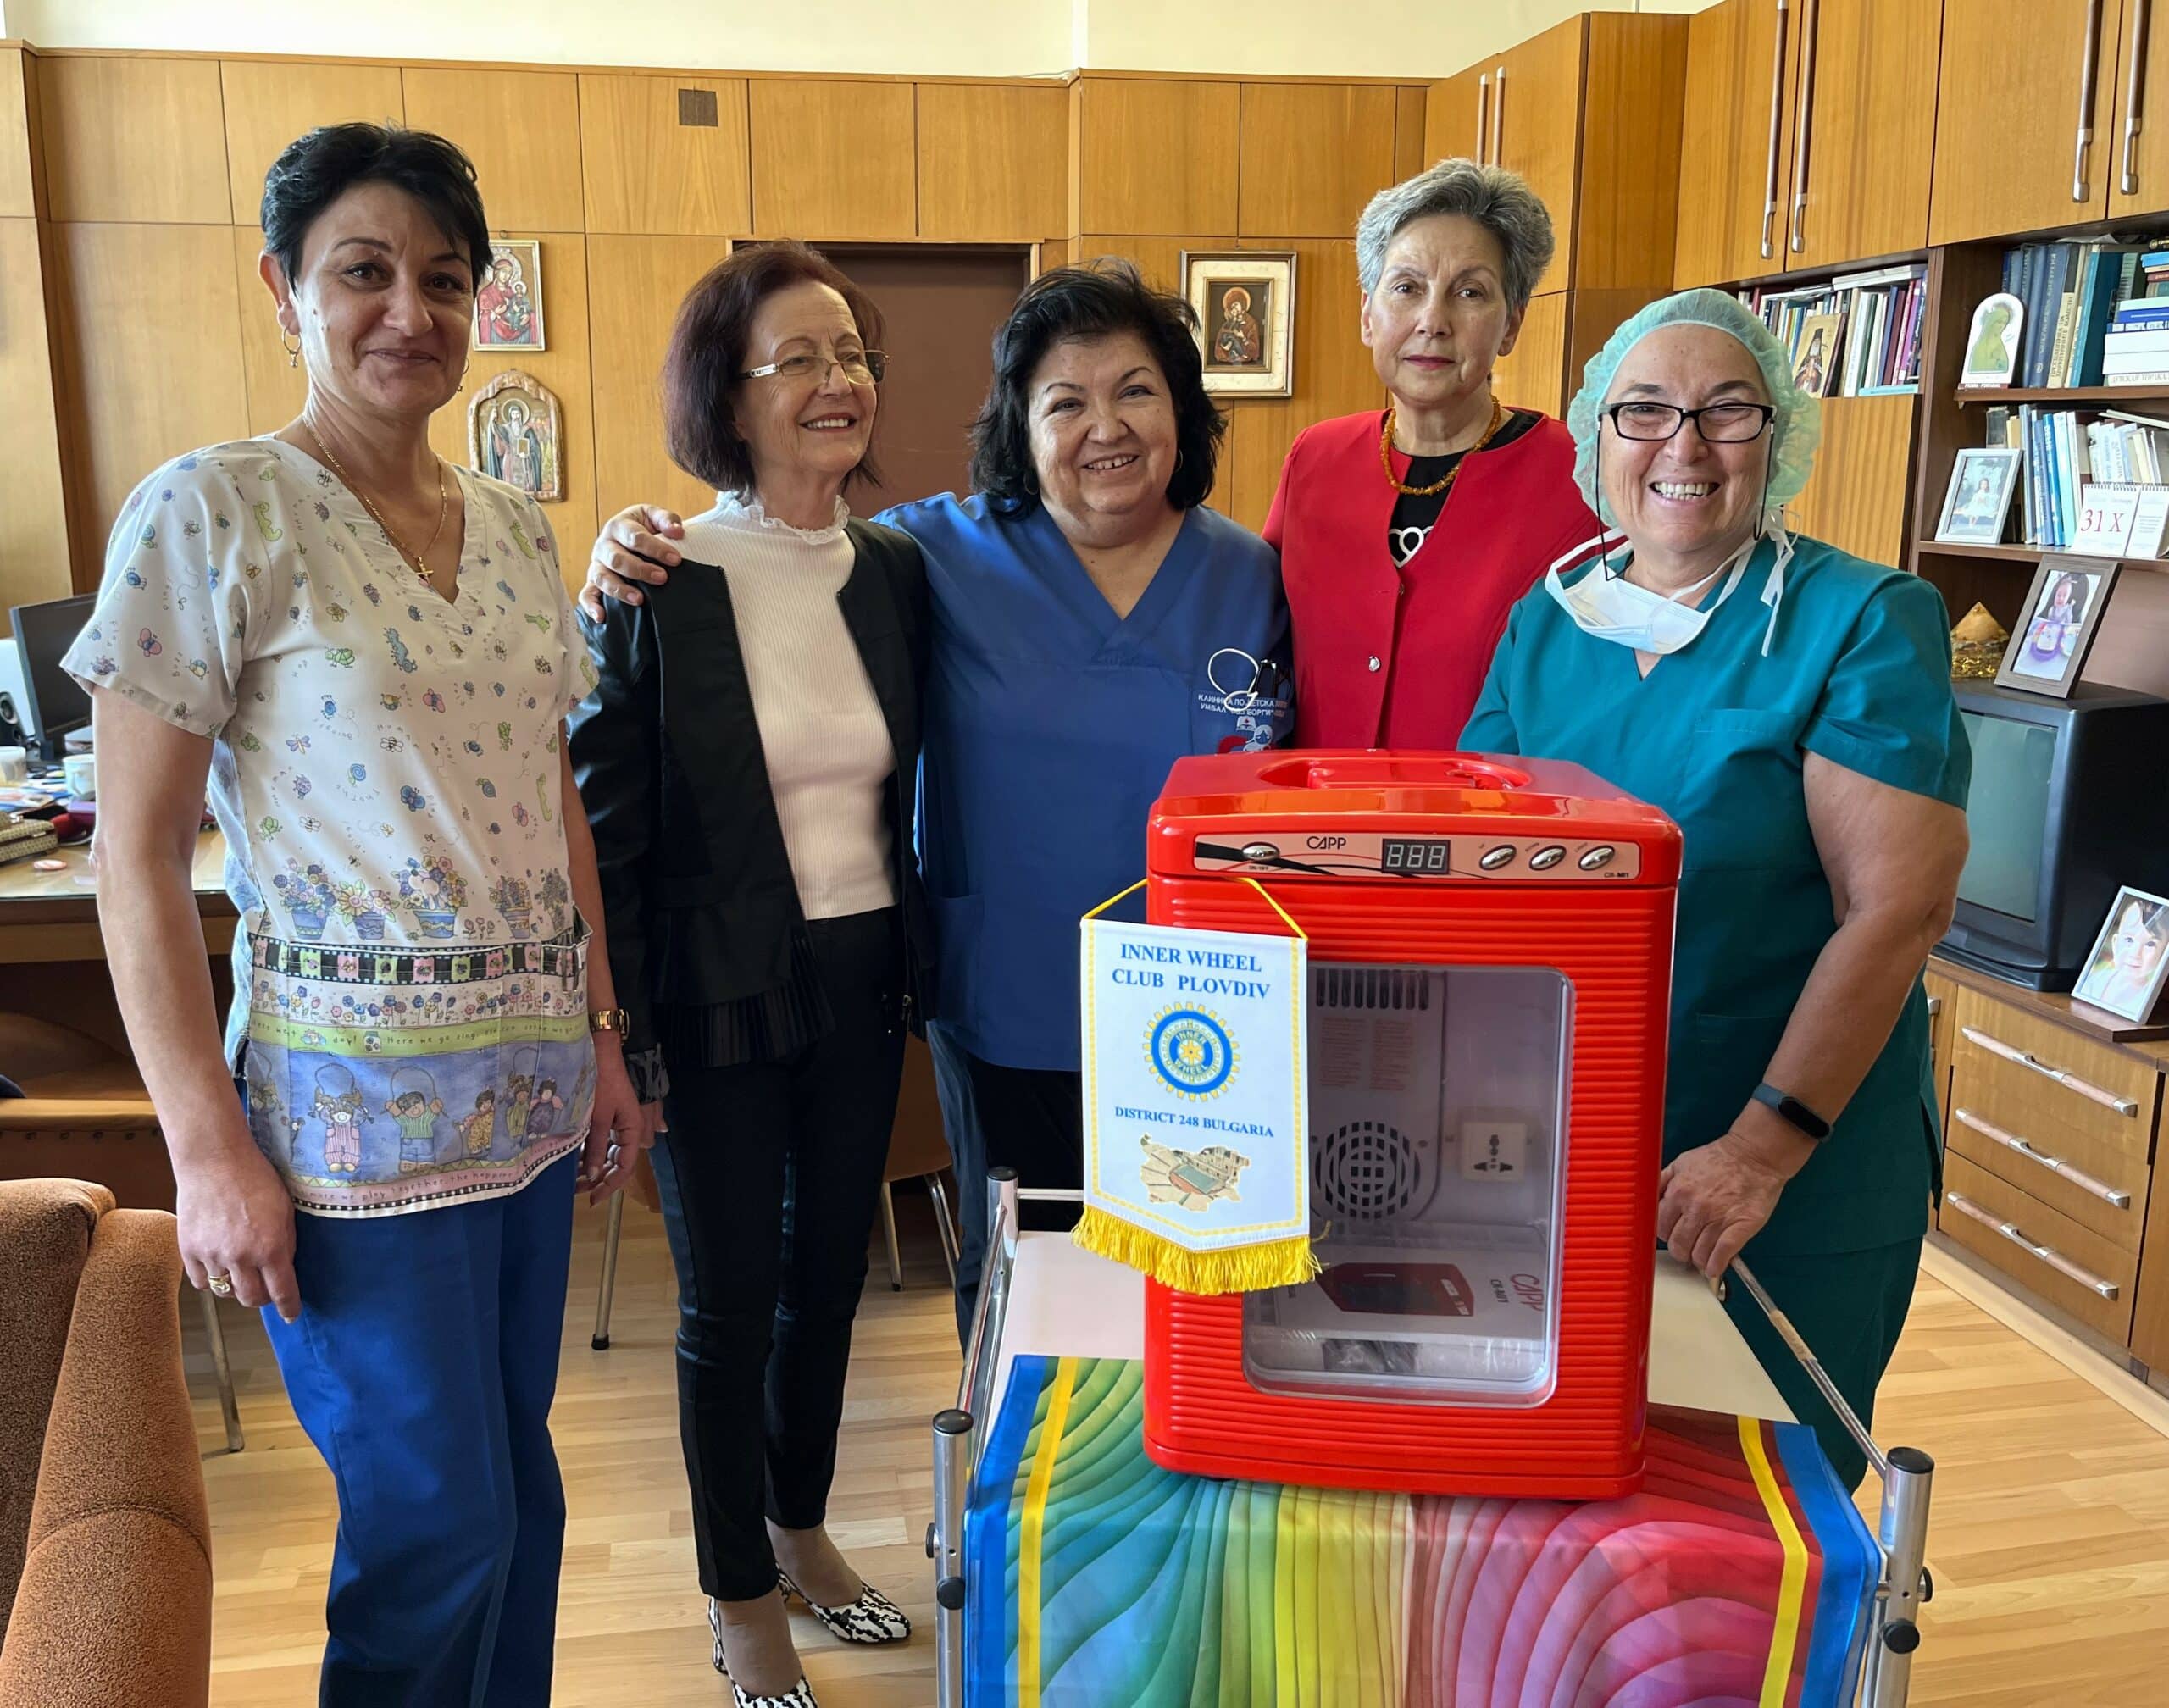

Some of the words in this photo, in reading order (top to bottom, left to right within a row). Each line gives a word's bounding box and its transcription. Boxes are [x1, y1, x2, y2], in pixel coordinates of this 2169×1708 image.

[2080, 508, 2104, 532] 31
[1234, 698, 1245, 707] ПО
[1246, 699, 1274, 707] ЕТСКА
[1306, 835, 1347, 850] CAPP
[1120, 942, 1182, 965] INNER
[1187, 950, 1262, 973] WHEEL
[1112, 968, 1164, 988] CLUB
[1177, 975, 1271, 1000] PLOVDIV
[1176, 1029, 1207, 1045] INNER
[1175, 1058, 1208, 1077] WHEEL
[1114, 1106, 1175, 1125] DISTRICT
[1179, 1113, 1200, 1127] 248
[1202, 1117, 1275, 1138] BULGARIA
[362, 1190, 386, 1202] play
